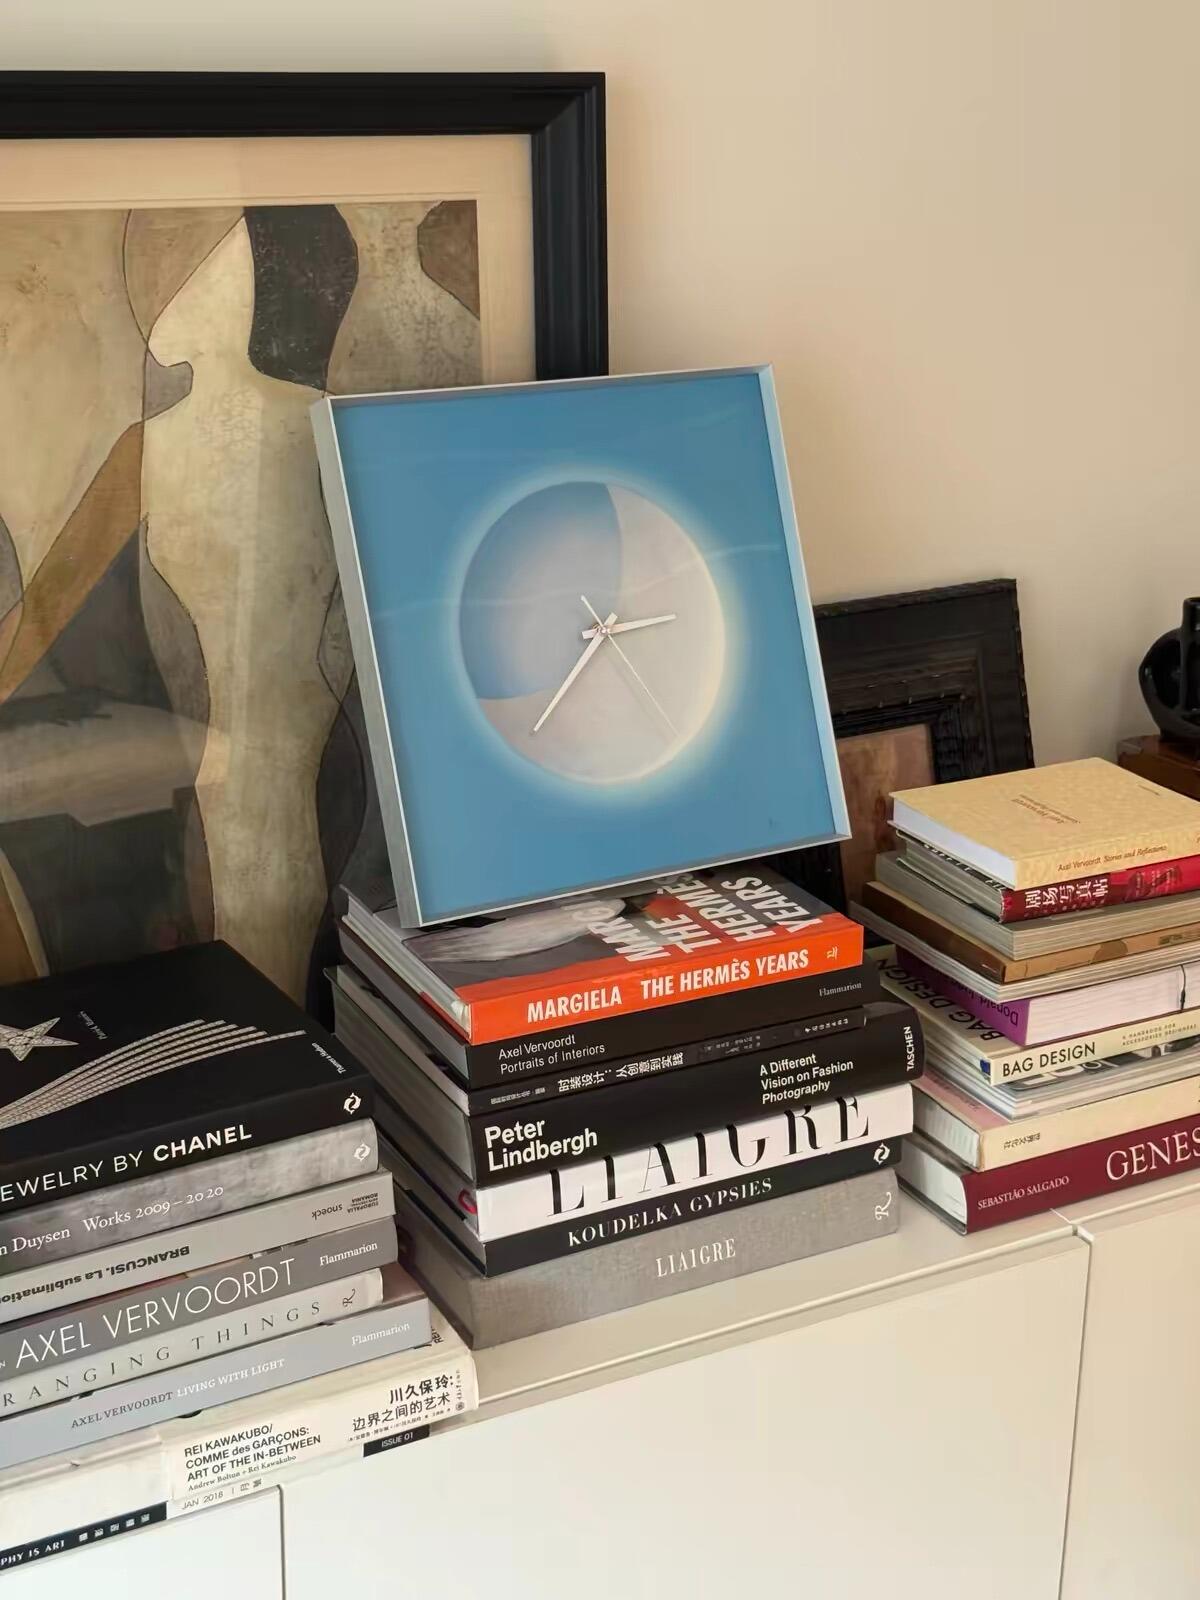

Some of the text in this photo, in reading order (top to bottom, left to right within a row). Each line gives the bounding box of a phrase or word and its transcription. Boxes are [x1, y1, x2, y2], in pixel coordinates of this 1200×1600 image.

[721, 877, 823, 933] YEARS
[645, 914, 722, 954] THE
[527, 949, 809, 1023] MARGIELA THE HERMÈS YEARS
[819, 981, 862, 997] Flammarion
[949, 1011, 1006, 1040] BAG
[499, 1034, 576, 1060] Axel Vervoordt
[500, 1043, 605, 1075] Portraits of Interiors
[760, 1053, 817, 1076] A Different
[904, 1026, 915, 1071] TASCHEN
[1003, 1041, 1095, 1077] BAG DESIGN
[761, 1059, 854, 1090] Vision on Fashion
[762, 1080, 831, 1104] Photography
[484, 1117, 545, 1150] Peter
[487, 1127, 598, 1172] Lindbergh
[0, 1124, 252, 1201] EWELRY BY CHANEL
[978, 1175, 1070, 1210] SEBASTIÃO SALGADO
[311, 1204, 343, 1220] snoeck
[568, 1177, 773, 1246] KOUDELKA GYPSIES
[12, 1228, 71, 1252] Duysen
[82, 1210, 131, 1232] Works
[86, 1269, 103, 1280] La
[106, 1245, 190, 1275] BRANCUSI.
[656, 1238, 736, 1277] LIAIGRE
[16, 1322, 91, 1368] AXEL
[103, 1258, 295, 1339] VERVOORDT
[320, 1243, 378, 1266] Flammarion
[192, 1301, 320, 1350] THINGS
[352, 1322, 410, 1346] Flammarion
[71, 1358, 285, 1428] AXEL VERVOORDT LIVING WITH LIGHT
[353, 1391, 450, 1432] 边界之间的艺术
[184, 1423, 273, 1457] REI KAWAKUBO/
[186, 1426, 309, 1469] COMME des GARÇONS:
[381, 1432, 414, 1447] ISSUE 01
[187, 1435, 321, 1482] ART OF THE IN-BETWEEN
[188, 1479, 215, 1491] Andrew
[249, 1464, 260, 1473] Rei
[261, 1455, 297, 1470] Kawakubo
[182, 1491, 224, 1510] JAN 2018
[0, 1540, 65, 1566] PHY IS ART
